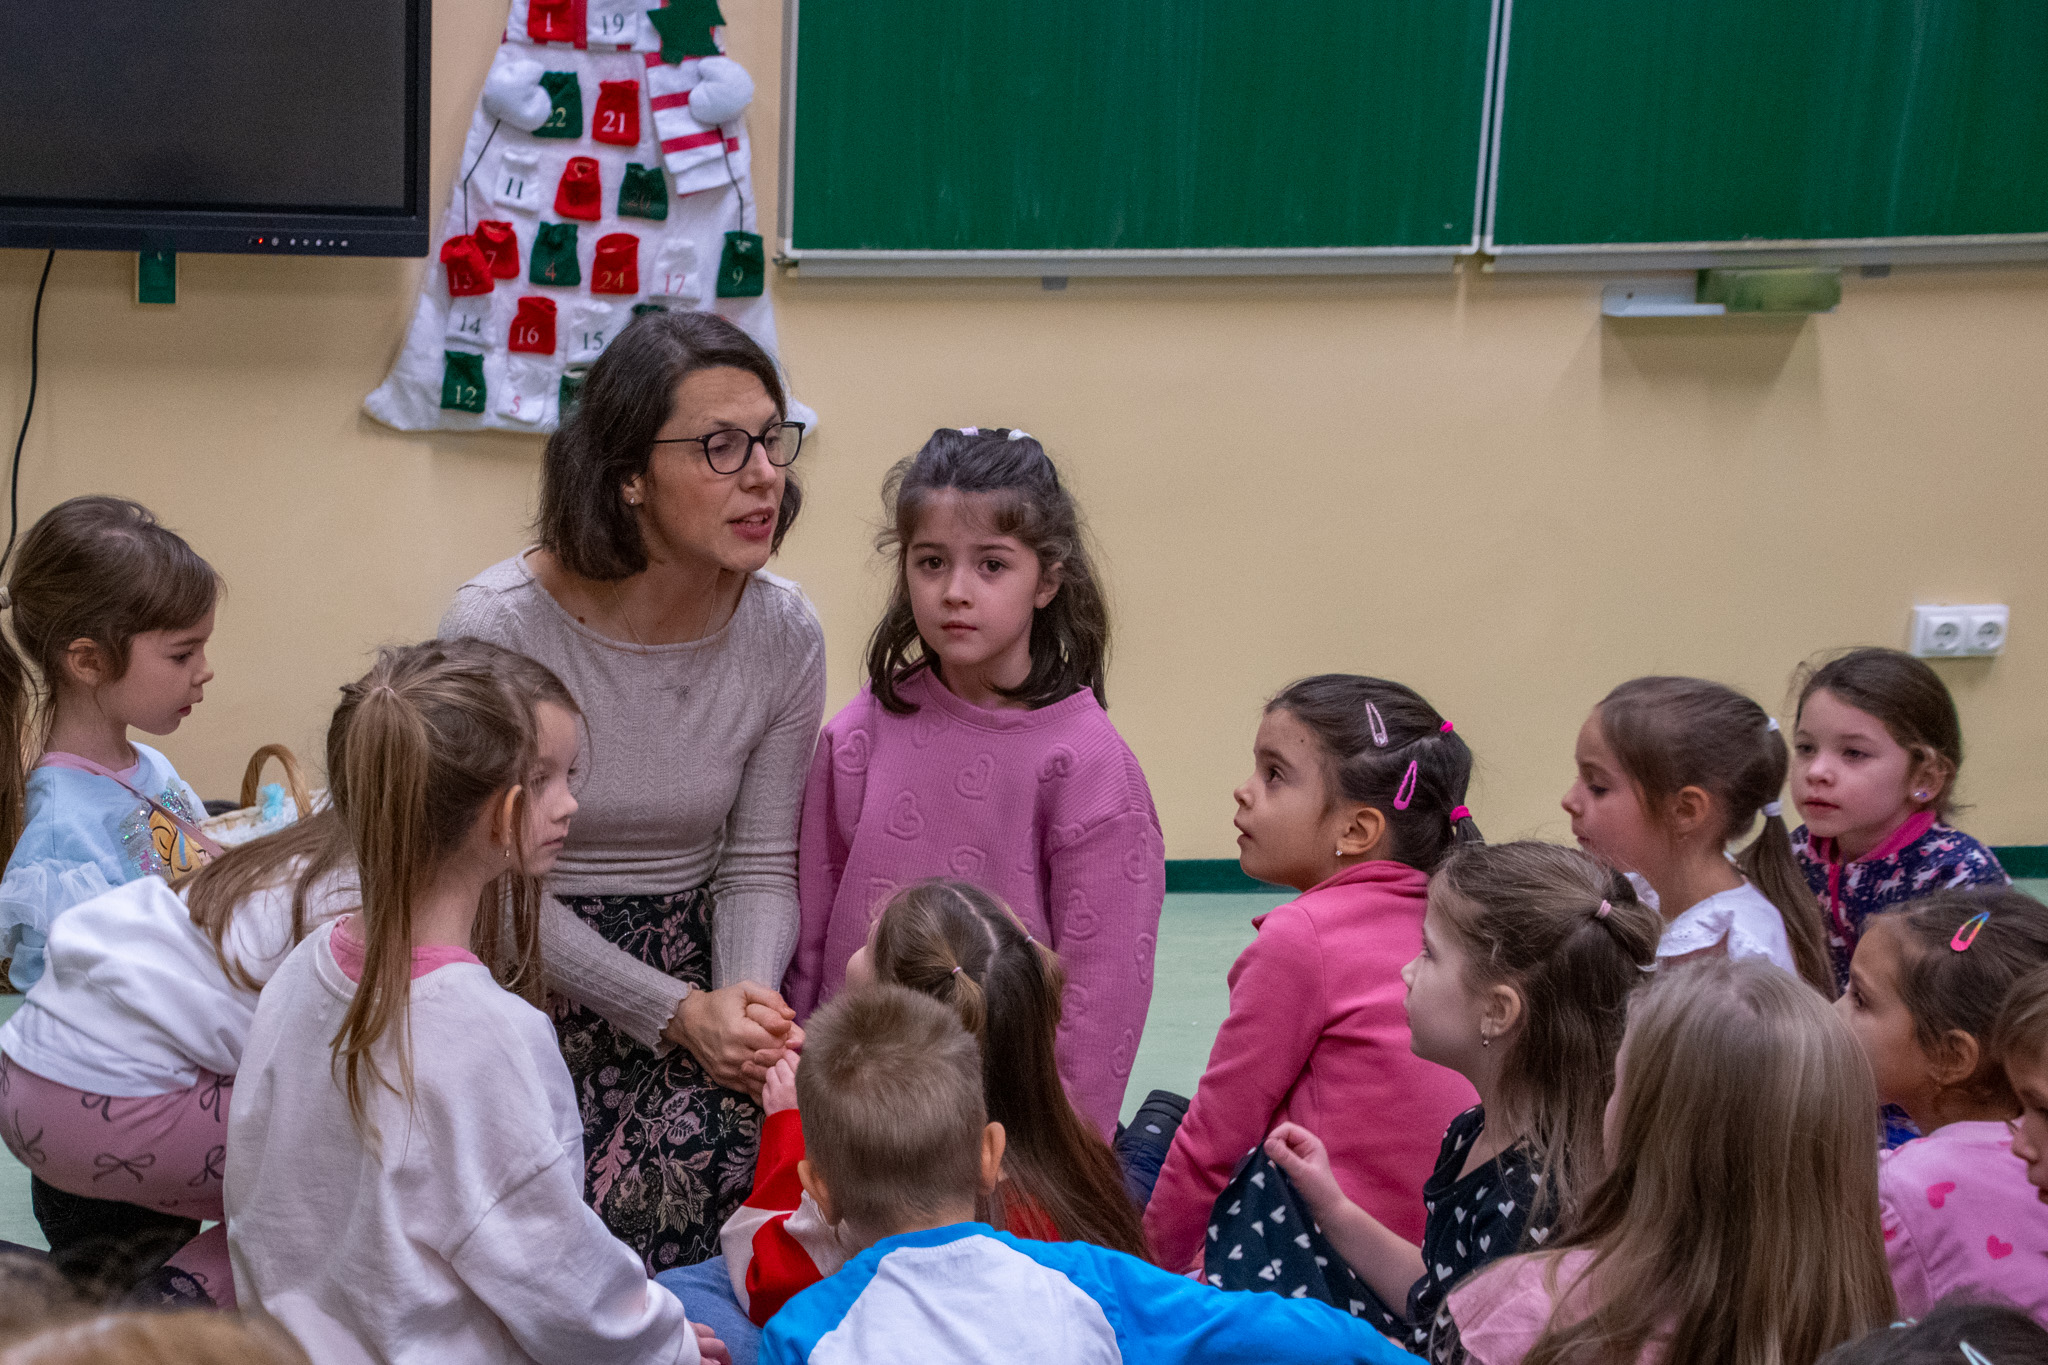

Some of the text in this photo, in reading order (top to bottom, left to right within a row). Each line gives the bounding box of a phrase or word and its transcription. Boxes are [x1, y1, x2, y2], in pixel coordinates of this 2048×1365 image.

[545, 12, 553, 33] 1
[602, 13, 625, 35] 19
[602, 110, 626, 133] 21
[505, 177, 524, 199] 11
[544, 258, 557, 283] 4
[598, 270, 625, 290] 24
[732, 266, 744, 287] 9
[665, 273, 685, 296] 17
[460, 314, 482, 335] 14
[517, 326, 540, 346] 16
[583, 331, 604, 350] 15
[455, 385, 478, 408] 12
[509, 395, 522, 416] 5
